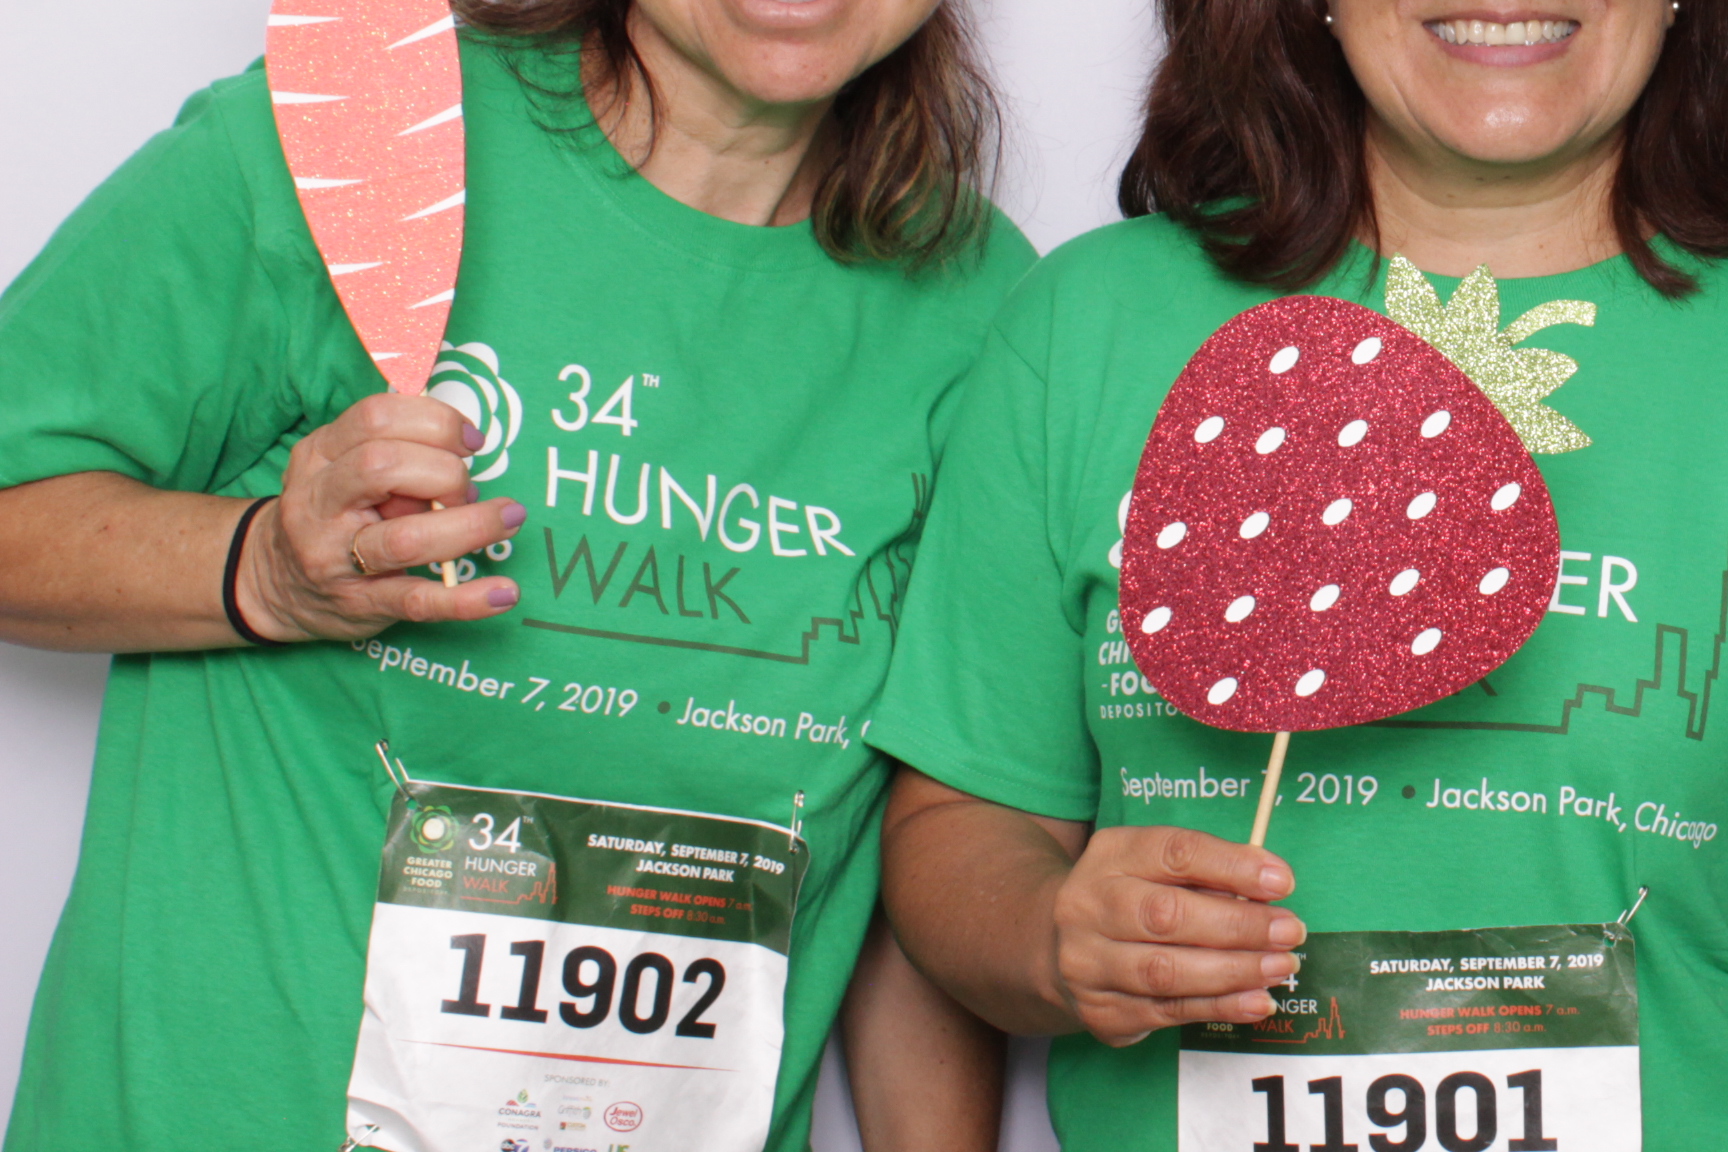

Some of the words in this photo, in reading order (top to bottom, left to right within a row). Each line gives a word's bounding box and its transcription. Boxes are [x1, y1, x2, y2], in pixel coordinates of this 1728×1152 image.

[546, 446, 856, 558] HUNGER
[543, 526, 752, 625] WALK
[521, 676, 550, 711] 7,
[557, 682, 639, 717] 2019
[1100, 701, 1178, 719] DEPOSITO
[676, 697, 786, 737] Jackson
[794, 712, 849, 749] Park,
[1121, 767, 1251, 804] September
[1296, 772, 1379, 805] 2019
[1426, 776, 1547, 814] Jackson
[1558, 786, 1627, 833] Park,
[1634, 801, 1718, 849] Chicago
[406, 856, 453, 869] GREATER
[587, 834, 666, 856] SATURDAY,
[670, 844, 738, 864] SEPTEMBER
[737, 852, 749, 867] 7,
[753, 855, 785, 875] 2019
[403, 866, 453, 879] CHICAGO
[464, 856, 537, 877] HUNGER
[636, 859, 701, 879] JACKSON
[702, 867, 735, 882] PARK
[411, 877, 442, 888] FOOD
[463, 875, 510, 893] WALK
[607, 885, 658, 900] HUNGER
[659, 891, 692, 904] WALK
[693, 895, 726, 908] OPENS
[727, 899, 735, 908] 7
[630, 904, 661, 917] STEPS
[662, 908, 685, 919] OFF
[686, 910, 709, 922] 8:30
[709, 914, 726, 924] a.m.
[1370, 958, 1454, 974] SATURDAY,
[1460, 955, 1546, 971] SEPTEMBER
[1549, 955, 1562, 970] 7,
[1567, 953, 1604, 968] 2019
[440, 933, 726, 1039] 11902
[1426, 976, 1500, 992] JACKSON
[1503, 976, 1545, 989] PARK
[1275, 999, 1318, 1014] NGER
[1400, 1008, 1455, 1019] HUNGER
[1457, 1006, 1496, 1017] WALK
[1498, 1005, 1542, 1016] OPENS
[1545, 1004, 1554, 1015] 7
[1556, 1006, 1580, 1015] a.m.
[1207, 1023, 1233, 1031] FOOD
[1252, 1019, 1294, 1033] WALK
[1427, 1024, 1463, 1036] STEPS
[1466, 1023, 1490, 1034] OFF
[1493, 1022, 1521, 1033] 8:30
[1523, 1023, 1547, 1032] a.m.
[544, 1074, 596, 1086] SPONSORED
[498, 1107, 541, 1118] CONAGRA
[609, 1106, 637, 1118] Jewel
[1251, 1069, 1558, 1152] 11901
